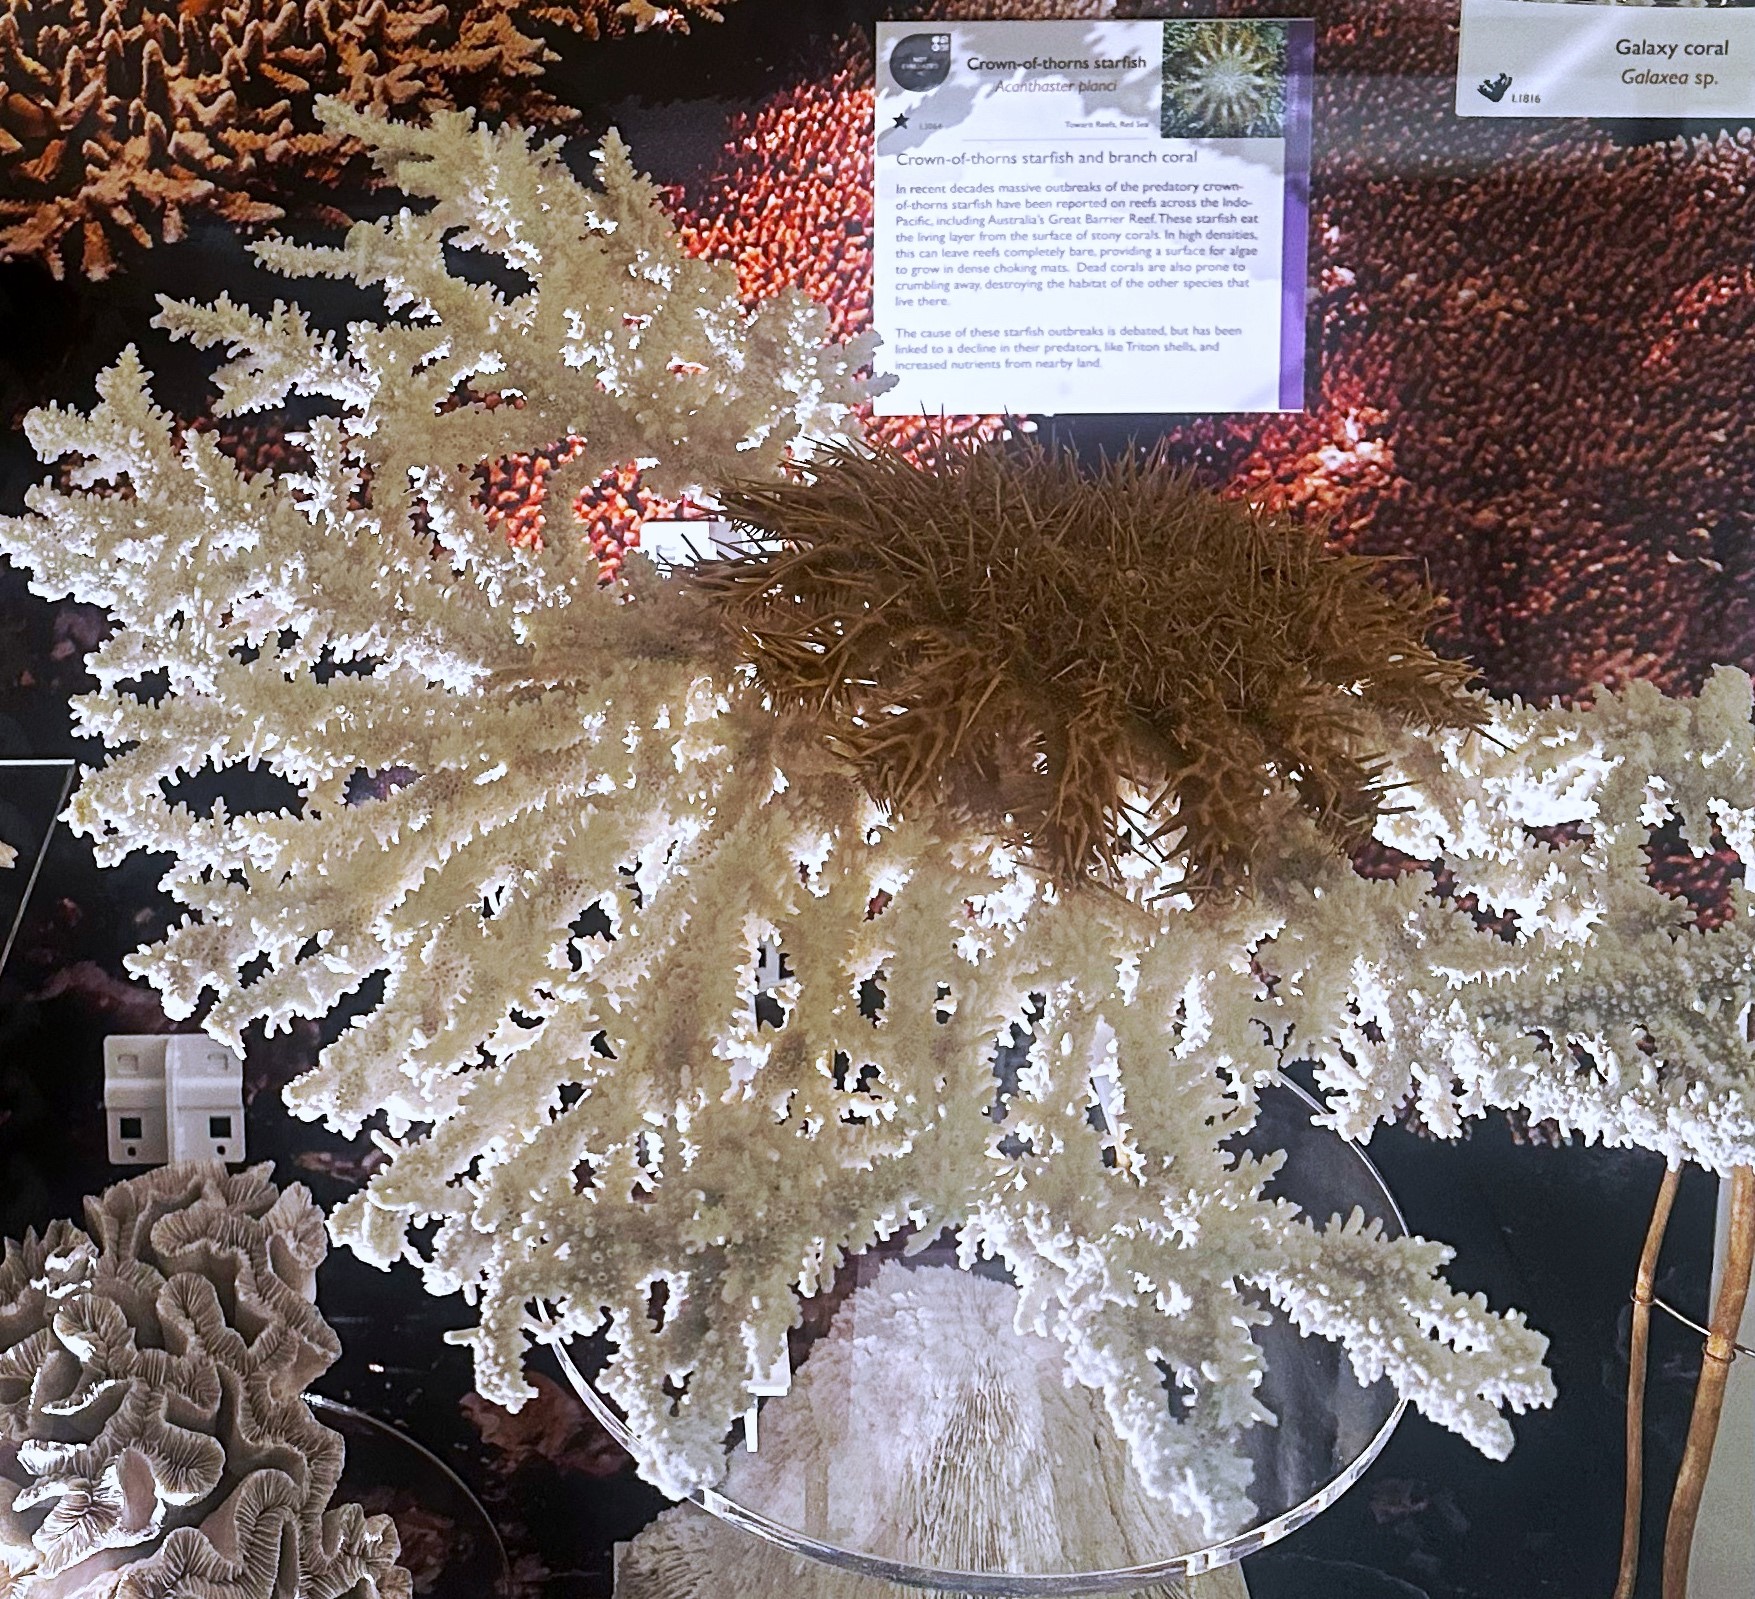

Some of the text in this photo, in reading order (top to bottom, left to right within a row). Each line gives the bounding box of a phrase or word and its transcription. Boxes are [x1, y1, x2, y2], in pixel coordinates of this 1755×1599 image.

[1616, 39, 1728, 59] Galaxy coral
[967, 56, 1147, 70] Crown-of-thorns starfish
[1622, 68, 1718, 88] Galaxea sp.
[995, 79, 1118, 94] Acanthaster planci
[896, 150, 1198, 165] Crown-of-thorns starfish and branch coral
[896, 183, 906, 193] In
[910, 184, 946, 193] recent
[950, 182, 994, 193] decades
[998, 183, 1041, 192] massive
[1045, 182, 1101, 192] outbreaks
[1104, 181, 1118, 192] of
[1120, 181, 1139, 192] the
[1142, 181, 1199, 194] predatory
[895, 199, 948, 209] of-thorns
[952, 198, 992, 209] starfish
[996, 198, 1021, 208] have
[1025, 198, 1052, 208] been
[1056, 198, 1107, 211] reported
[1129, 198, 1156, 208] reefs
[1200, 197, 1219, 208] the
[1222, 197, 1252, 207] Indo-
[936, 214, 985, 228] including
[987, 214, 1044, 225] Australia's
[1048, 213, 1081, 225] Great
[1085, 213, 1125, 224] Barrier
[1195, 212, 1237, 224] starfish
[1240, 214, 1259, 224] eat
[896, 231, 913, 241] the
[918, 230, 945, 243] living
[949, 230, 975, 243] layer
[979, 230, 1006, 240] from
[1010, 230, 1028, 240] the
[1032, 230, 1072, 240] surface
[1076, 230, 1088, 240] of
[1091, 231, 1121, 243] stony
[1164, 229, 1175, 240] In
[1178, 229, 1202, 242] high
[895, 247, 915, 258] this
[942, 247, 969, 257] leave
[973, 247, 1000, 257] reefs
[1004, 246, 1065, 260] completely
[1100, 246, 1152, 259] providing
[1165, 246, 1205, 256] surface
[1208, 245, 1226, 256] for
[1229, 245, 1258, 258] algae
[895, 264, 908, 273] to
[910, 266, 940, 276] grow
[943, 264, 953, 273] in
[957, 263, 990, 273] dense
[993, 262, 1037, 275] choking
[1076, 262, 1106, 272] Dead
[1110, 262, 1144, 272] corals
[1169, 262, 1192, 272] also
[1195, 264, 1230, 274] prone
[1232, 263, 1246, 272] to
[895, 279, 950, 292] crumbling
[984, 279, 1042, 291] destroying
[1047, 278, 1064, 288] the
[1068, 278, 1106, 288] habitat
[1110, 278, 1122, 288] of
[1126, 278, 1144, 288] the
[1147, 278, 1179, 288] other
[1183, 279, 1223, 290] species
[1227, 277, 1249, 287] that
[896, 296, 913, 306] live
[896, 327, 916, 337] The
[955, 327, 966, 337] of
[970, 327, 1000, 337] these
[1004, 327, 1044, 336] starfish
[1048, 326, 1104, 336] outbreaks
[1108, 327, 1116, 336] is
[1170, 326, 1188, 336] but
[1192, 326, 1210, 335] has
[1214, 325, 1242, 335] been
[895, 343, 928, 353] linked
[931, 344, 943, 353] to
[957, 343, 996, 353] decline
[1000, 344, 1010, 352] in
[1014, 342, 1040, 352] their
[1104, 342, 1123, 352] like
[1126, 342, 1160, 352] Triton
[1200, 341, 1219, 351] and
[895, 359, 946, 369] increased
[951, 360, 1000, 368] nutrients
[1004, 358, 1031, 368] from
[1036, 358, 1073, 370] nearby
